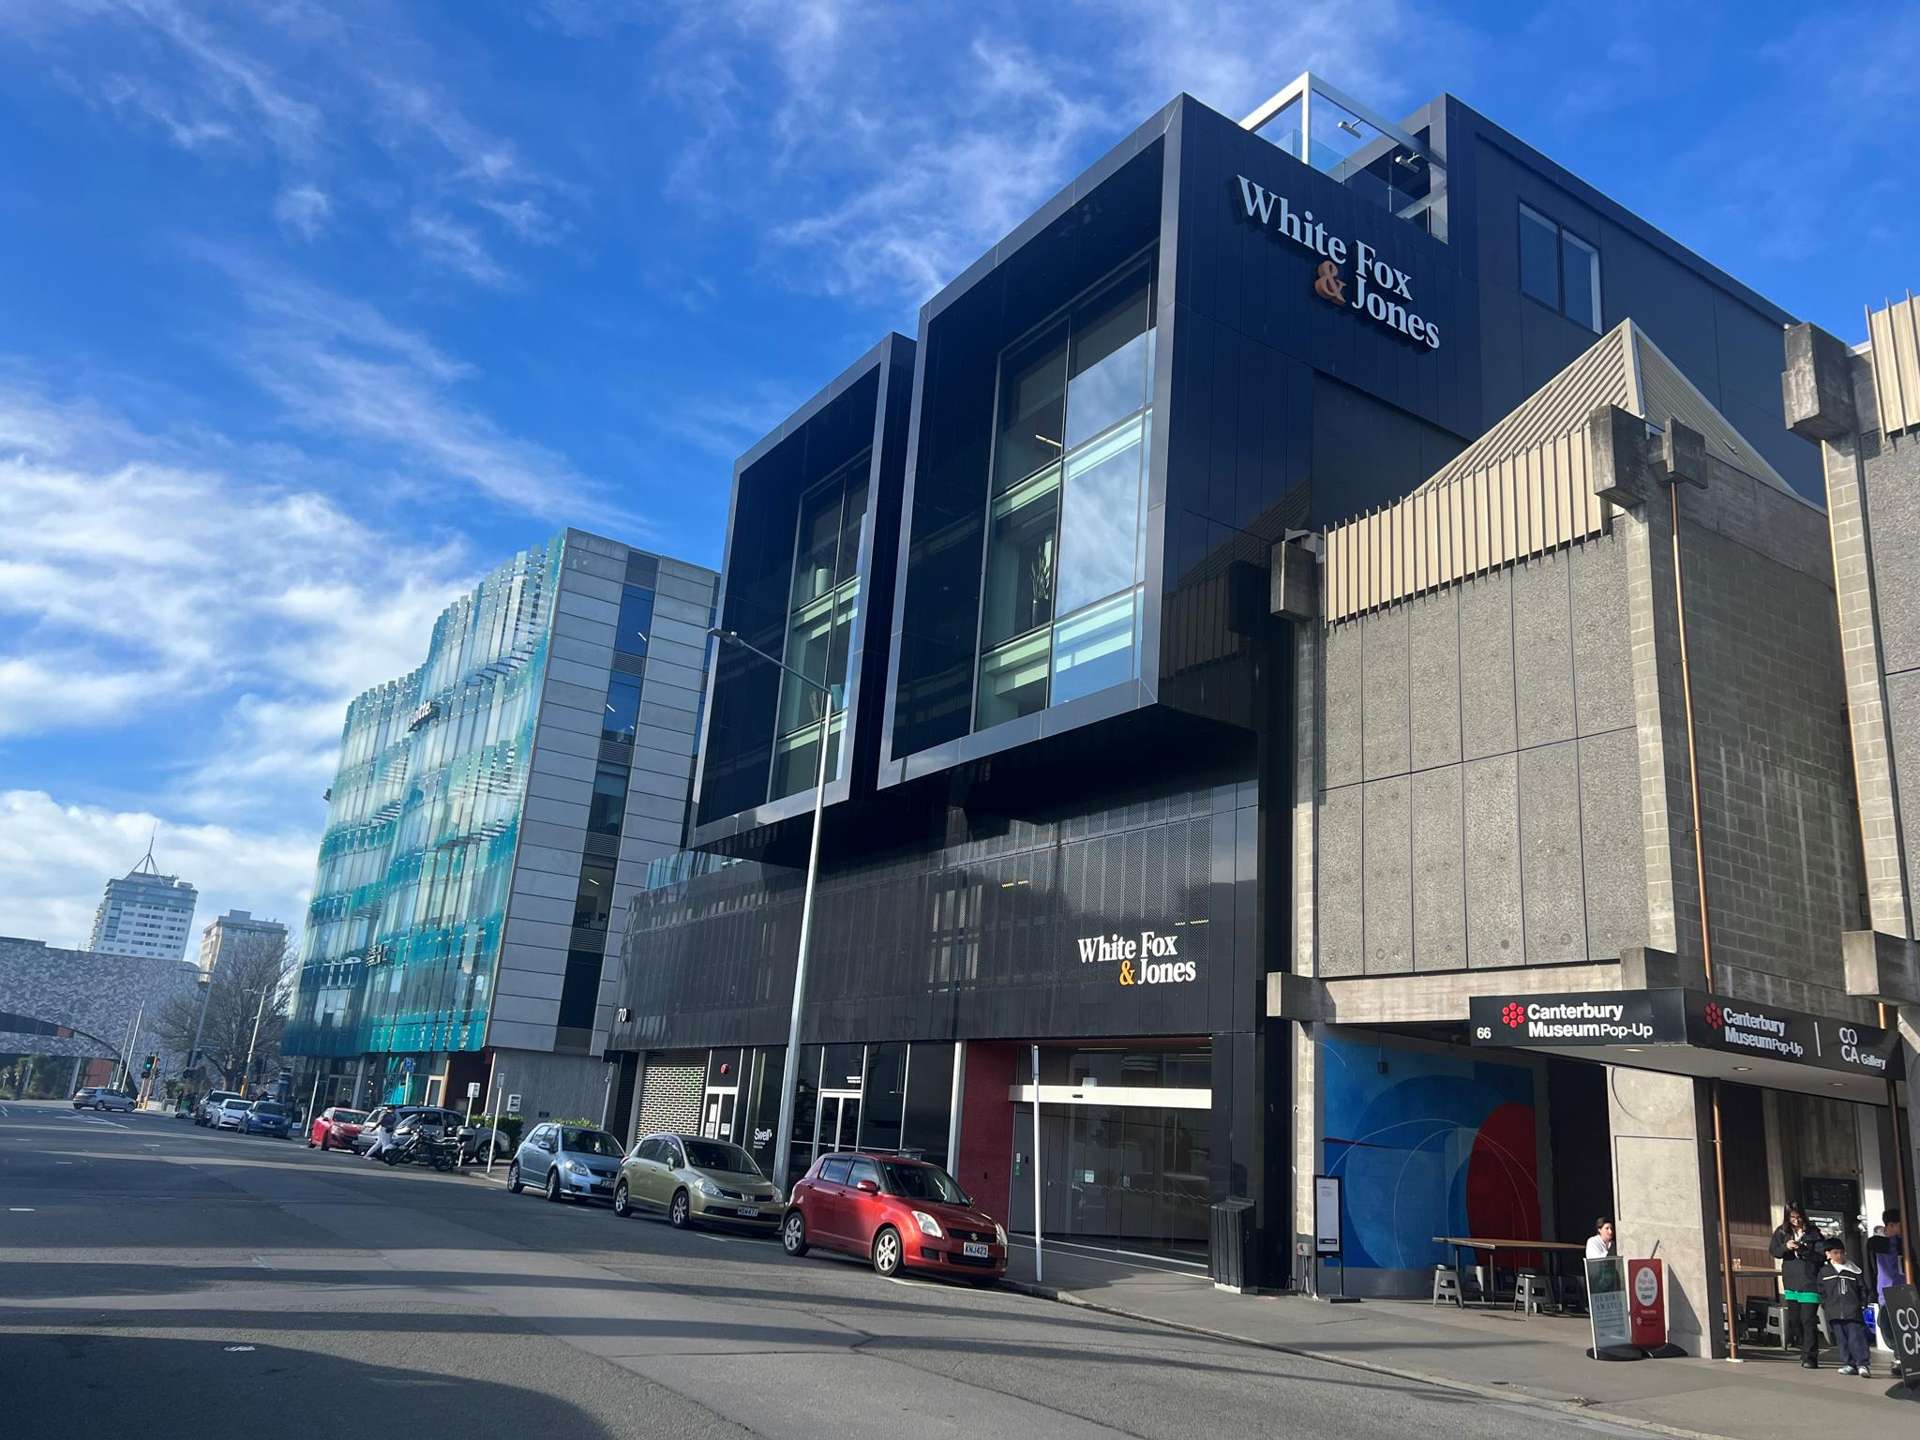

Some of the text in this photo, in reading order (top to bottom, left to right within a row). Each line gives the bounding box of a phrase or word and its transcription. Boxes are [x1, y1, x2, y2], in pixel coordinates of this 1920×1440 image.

[1237, 174, 1414, 302] White Fox
[1314, 260, 1440, 350] & Jones
[1077, 931, 1178, 964] White Fox
[1119, 958, 1197, 986] & Jones
[1527, 1002, 1624, 1022] Canterbury
[1723, 1007, 1786, 1038] Canterbury
[1476, 1026, 1492, 1040] 66
[1838, 1026, 1858, 1045] CO
[1841, 1045, 1886, 1070] CA Gallery
[1896, 1307, 1919, 1331] CO
